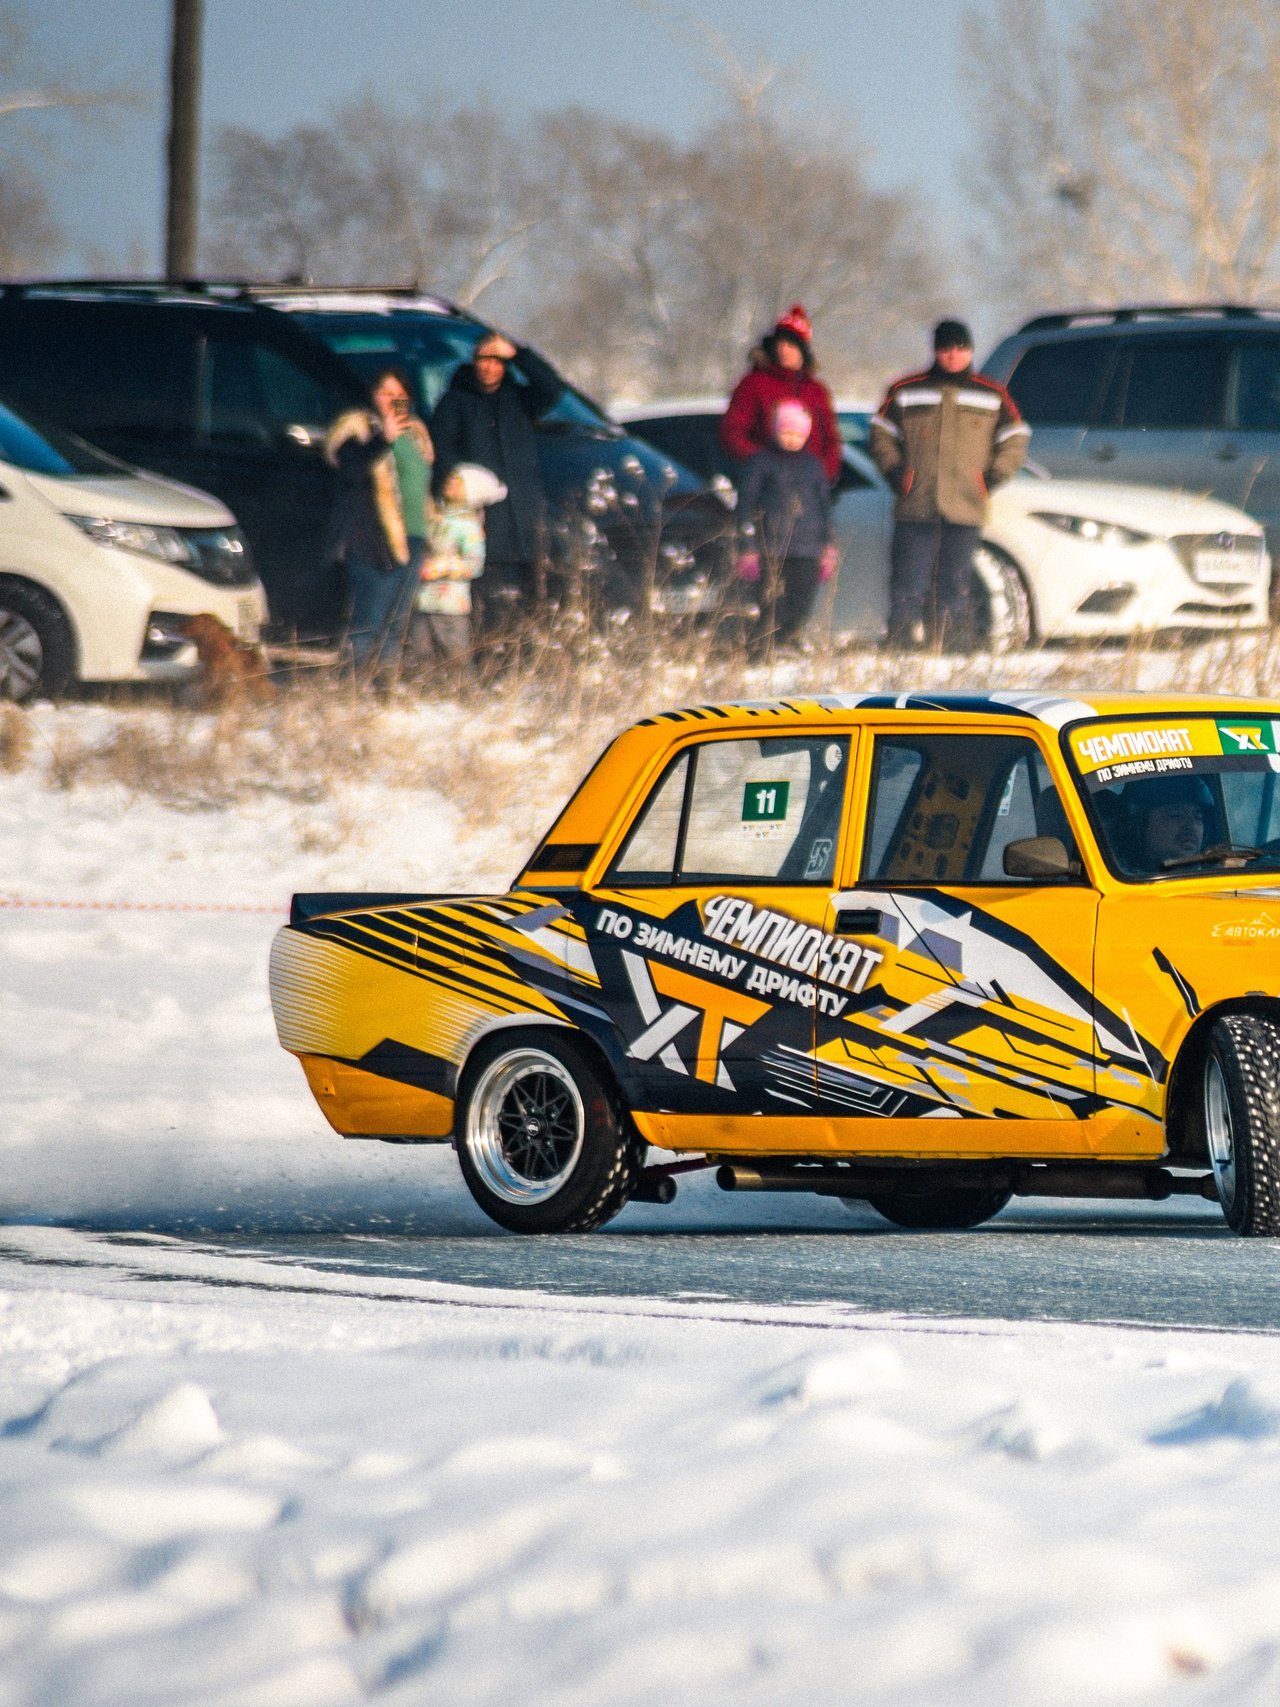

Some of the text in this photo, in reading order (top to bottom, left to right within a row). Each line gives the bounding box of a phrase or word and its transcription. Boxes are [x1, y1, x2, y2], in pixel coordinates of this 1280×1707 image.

[1078, 728, 1193, 763] ЧЕМПИОНАТ
[1096, 757, 1193, 783] ПО ЗИМНЕМУ ДРИФТУ
[755, 788, 777, 814] 11
[703, 894, 883, 993] ЧЕМПИОНАТ
[596, 909, 849, 1018] ПО ЗИМНЕМУ ДРИФТУ
